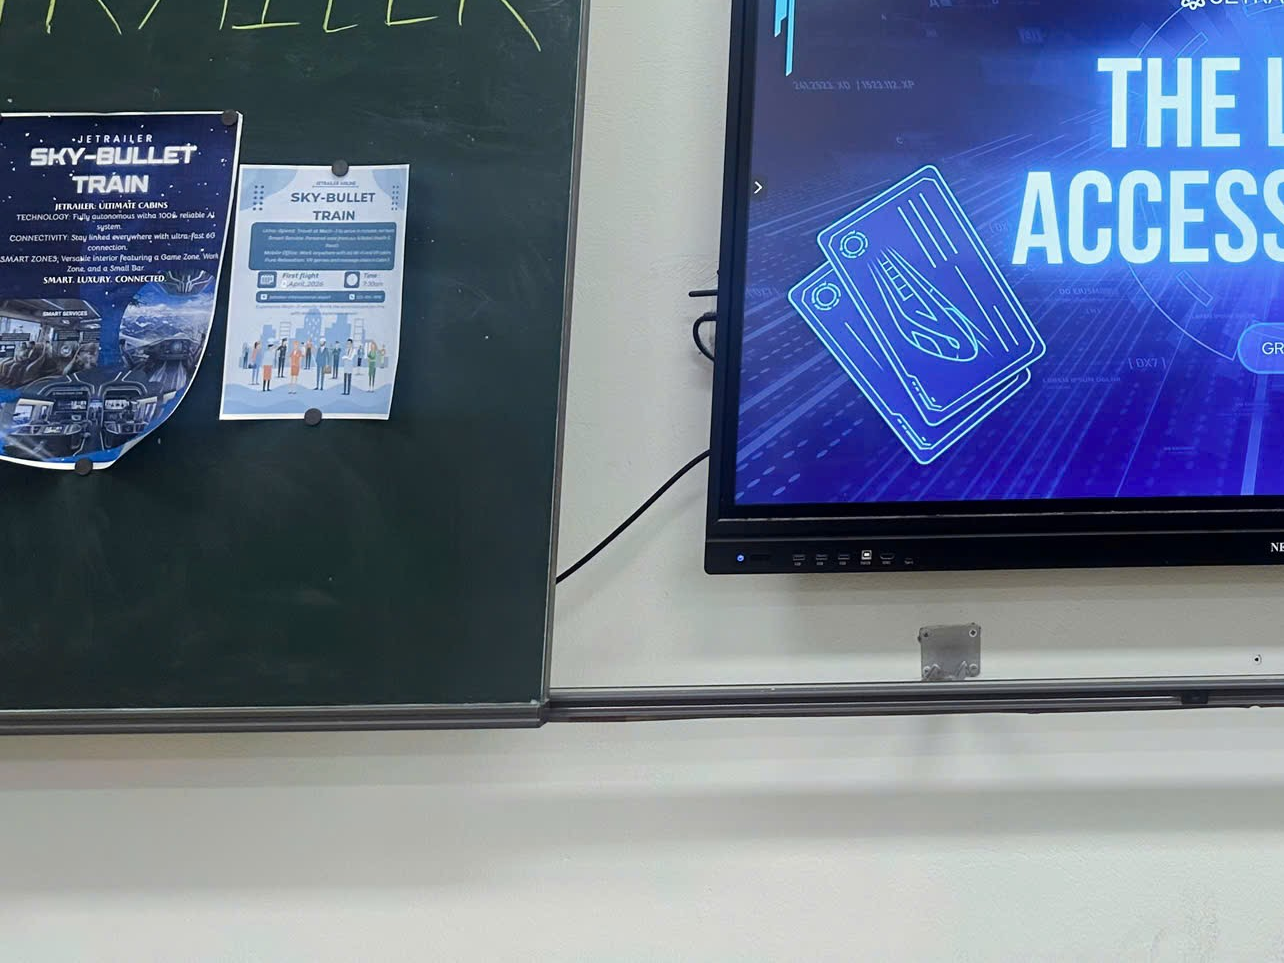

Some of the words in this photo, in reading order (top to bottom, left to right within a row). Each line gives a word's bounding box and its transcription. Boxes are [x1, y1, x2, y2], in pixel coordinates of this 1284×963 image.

[1098, 57, 1241, 149] THE
[77, 134, 153, 144] JETRAILER
[30, 144, 198, 166] SKY-BULLET
[71, 175, 150, 194] TRAIN
[290, 192, 376, 203] SKY-BULLET
[98, 202, 136, 210] ULTIMATE
[137, 201, 169, 209] CABINS
[72, 213, 91, 222] Fully
[179, 211, 205, 219] reliable
[312, 210, 356, 221] TRAIN
[71, 234, 88, 242] Stay
[88, 233, 111, 241] linked
[111, 232, 153, 242] everywhere
[153, 232, 170, 240] with
[170, 231, 205, 241] ultra-fast
[0, 255, 29, 263] SMART
[119, 253, 153, 263] featuring
[160, 253, 182, 261] Game
[87, 264, 101, 272] and
[109, 264, 130, 272] Small
